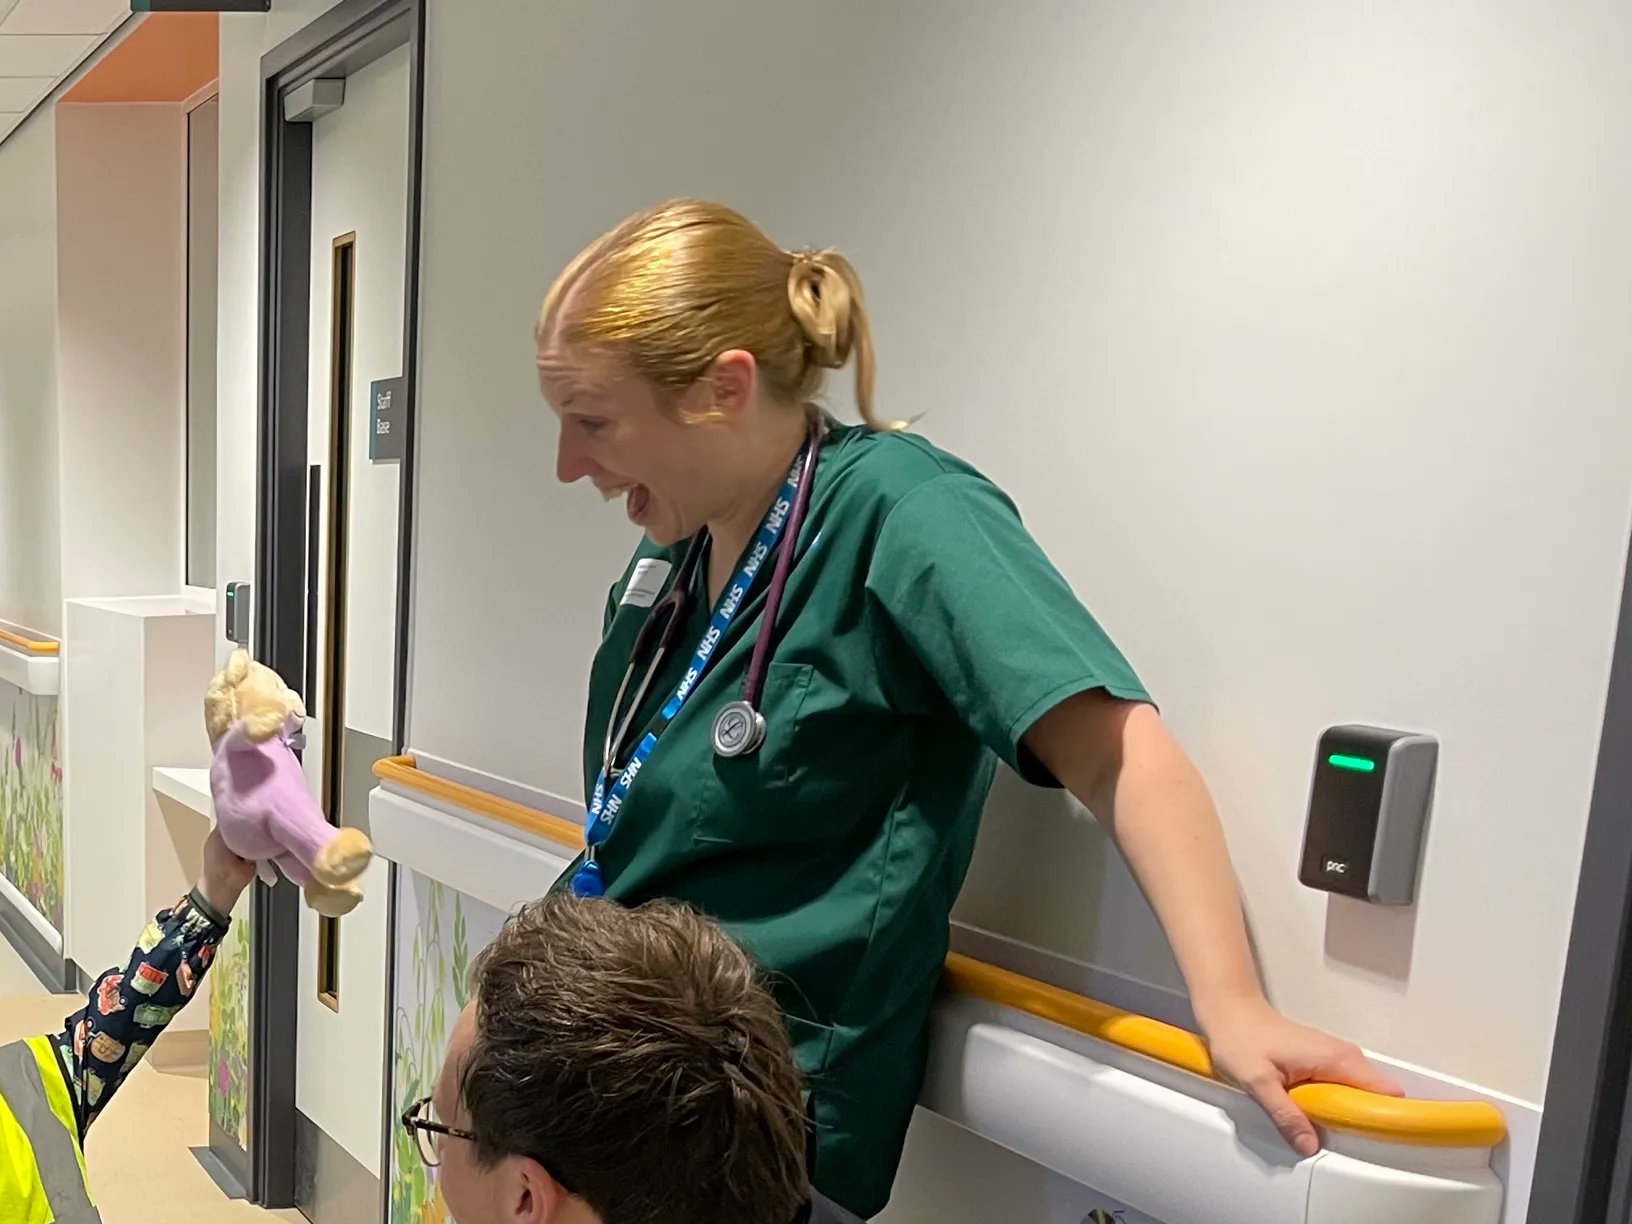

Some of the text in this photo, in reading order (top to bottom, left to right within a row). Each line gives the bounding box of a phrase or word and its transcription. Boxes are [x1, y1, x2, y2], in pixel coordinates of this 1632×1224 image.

[377, 391, 392, 410] Staff
[766, 496, 790, 535] NHS
[743, 541, 768, 578] NHS
[719, 583, 744, 619] NHS
[697, 625, 721, 661] NHS
[676, 666, 698, 700] NHS
[591, 783, 604, 815] NHS
[600, 757, 642, 825] NHS NHS
